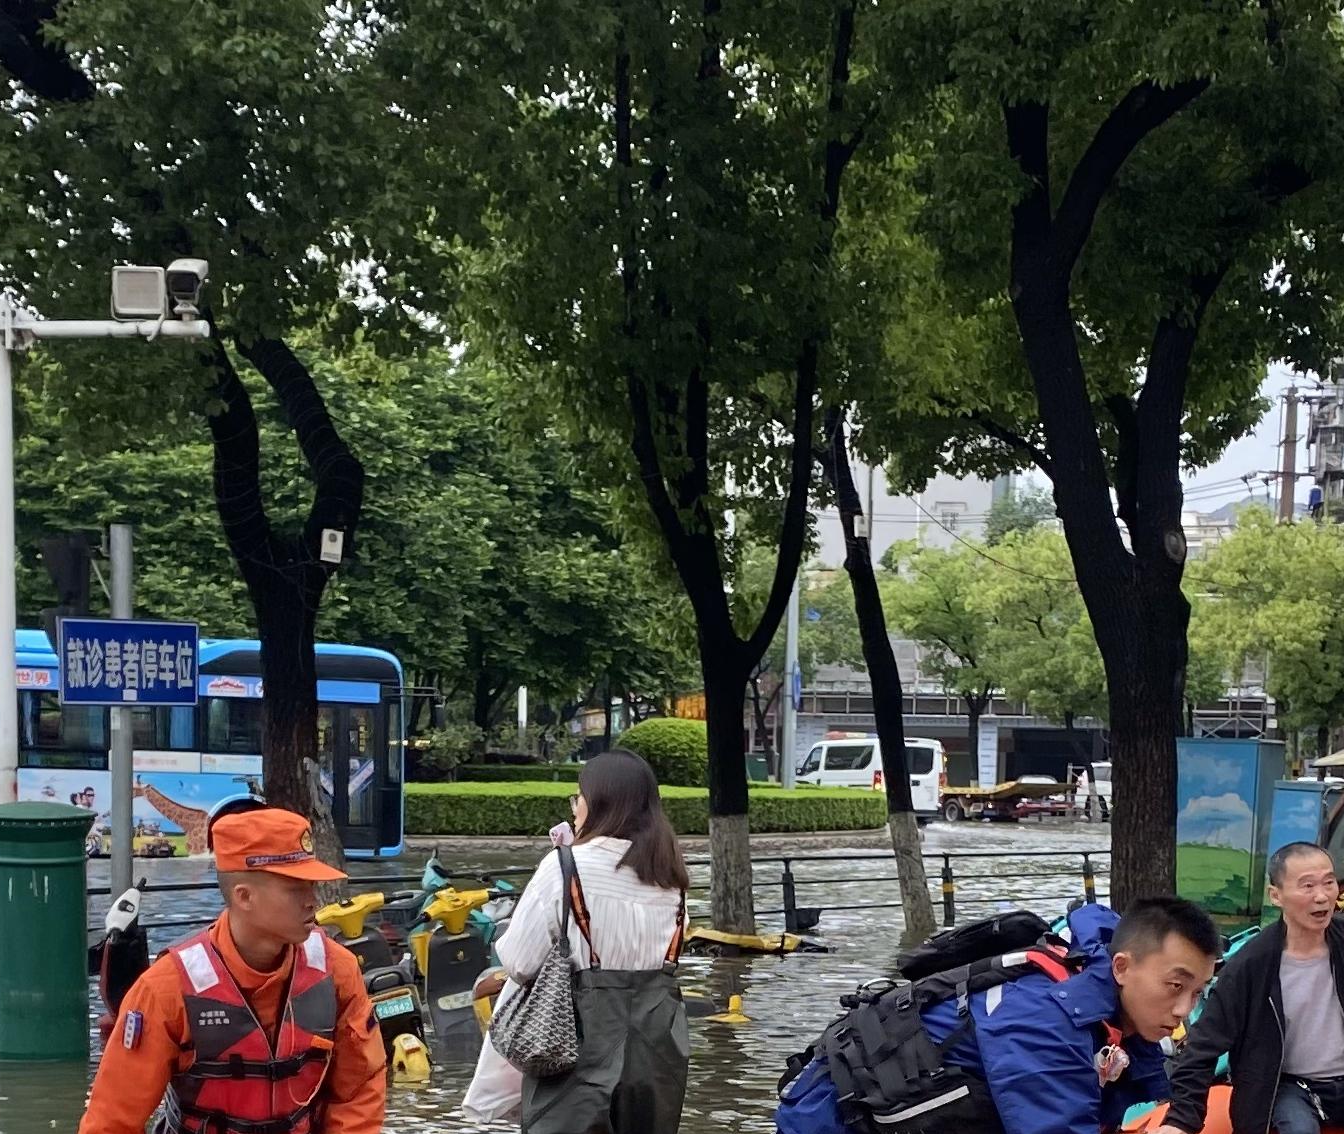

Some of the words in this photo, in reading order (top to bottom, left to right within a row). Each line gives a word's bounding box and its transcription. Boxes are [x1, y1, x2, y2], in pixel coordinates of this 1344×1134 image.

[67, 637, 193, 690] 就诊患者停车位
